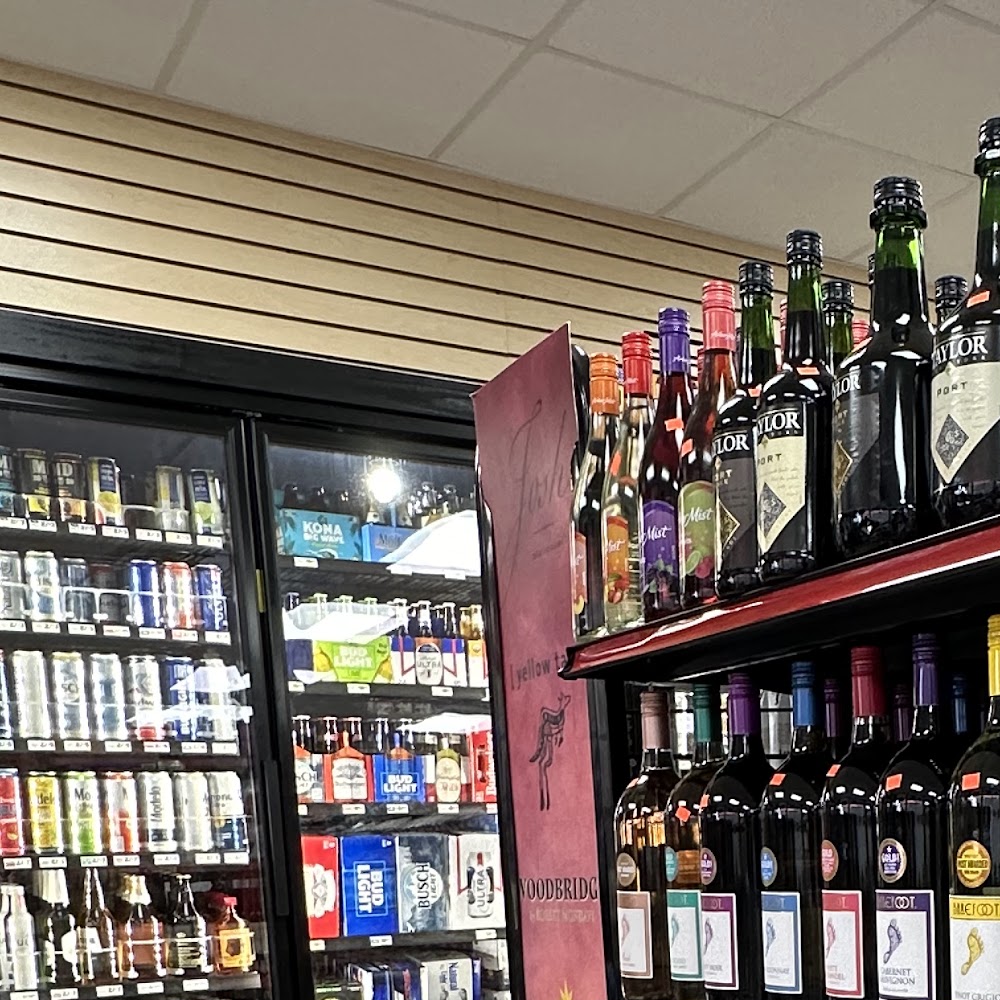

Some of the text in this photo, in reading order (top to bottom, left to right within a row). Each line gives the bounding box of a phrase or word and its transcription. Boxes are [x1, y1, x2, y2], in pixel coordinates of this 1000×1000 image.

[936, 380, 967, 397] PORT
[757, 411, 801, 435] YLOR
[685, 507, 714, 526] Mist
[302, 521, 343, 535] KONA
[641, 525, 671, 546] Mist
[383, 782, 418, 793] LIGHT
[387, 774, 414, 783] BUD
[357, 864, 372, 914] LIGHT
[370, 870, 385, 906] BUD
[417, 862, 431, 910] BUSCH
[476, 869, 486, 908] ULTRA
[519, 876, 599, 902] OODBRIDG
